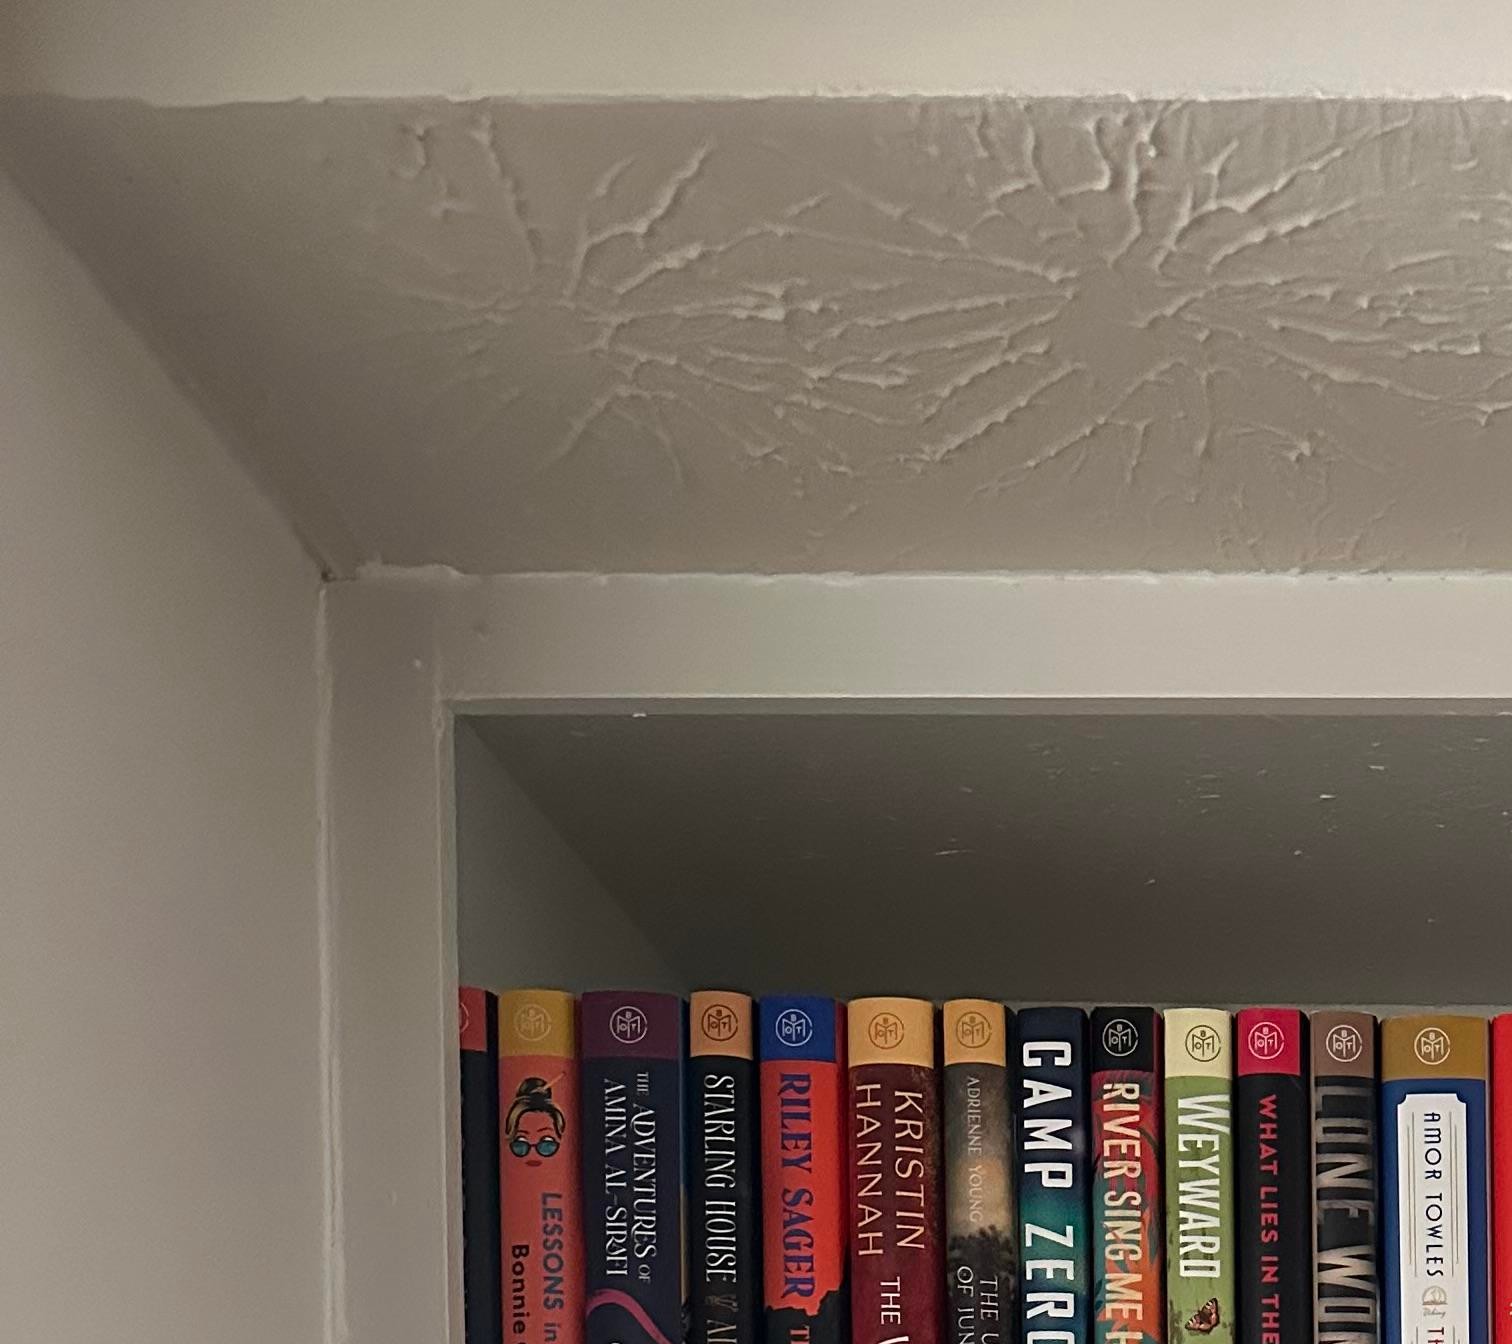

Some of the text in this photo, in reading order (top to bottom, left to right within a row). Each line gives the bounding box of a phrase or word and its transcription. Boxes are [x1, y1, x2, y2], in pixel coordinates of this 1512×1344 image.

[704, 1074, 736, 1282] STARLING HOUSE
[779, 1073, 816, 1298] RILEY SAGER
[856, 1083, 884, 1257] HANNAH
[895, 1090, 924, 1249] KRISTIN
[1023, 1041, 1072, 1188] CAMP
[1176, 1095, 1230, 1278] WEYWARD
[542, 1192, 564, 1311] LESSONS
[1423, 1112, 1444, 1277] AMOR TOWLES
[511, 1243, 530, 1334] Bonnie
[544, 1321, 558, 1342] in
[880, 1276, 900, 1324] THE
